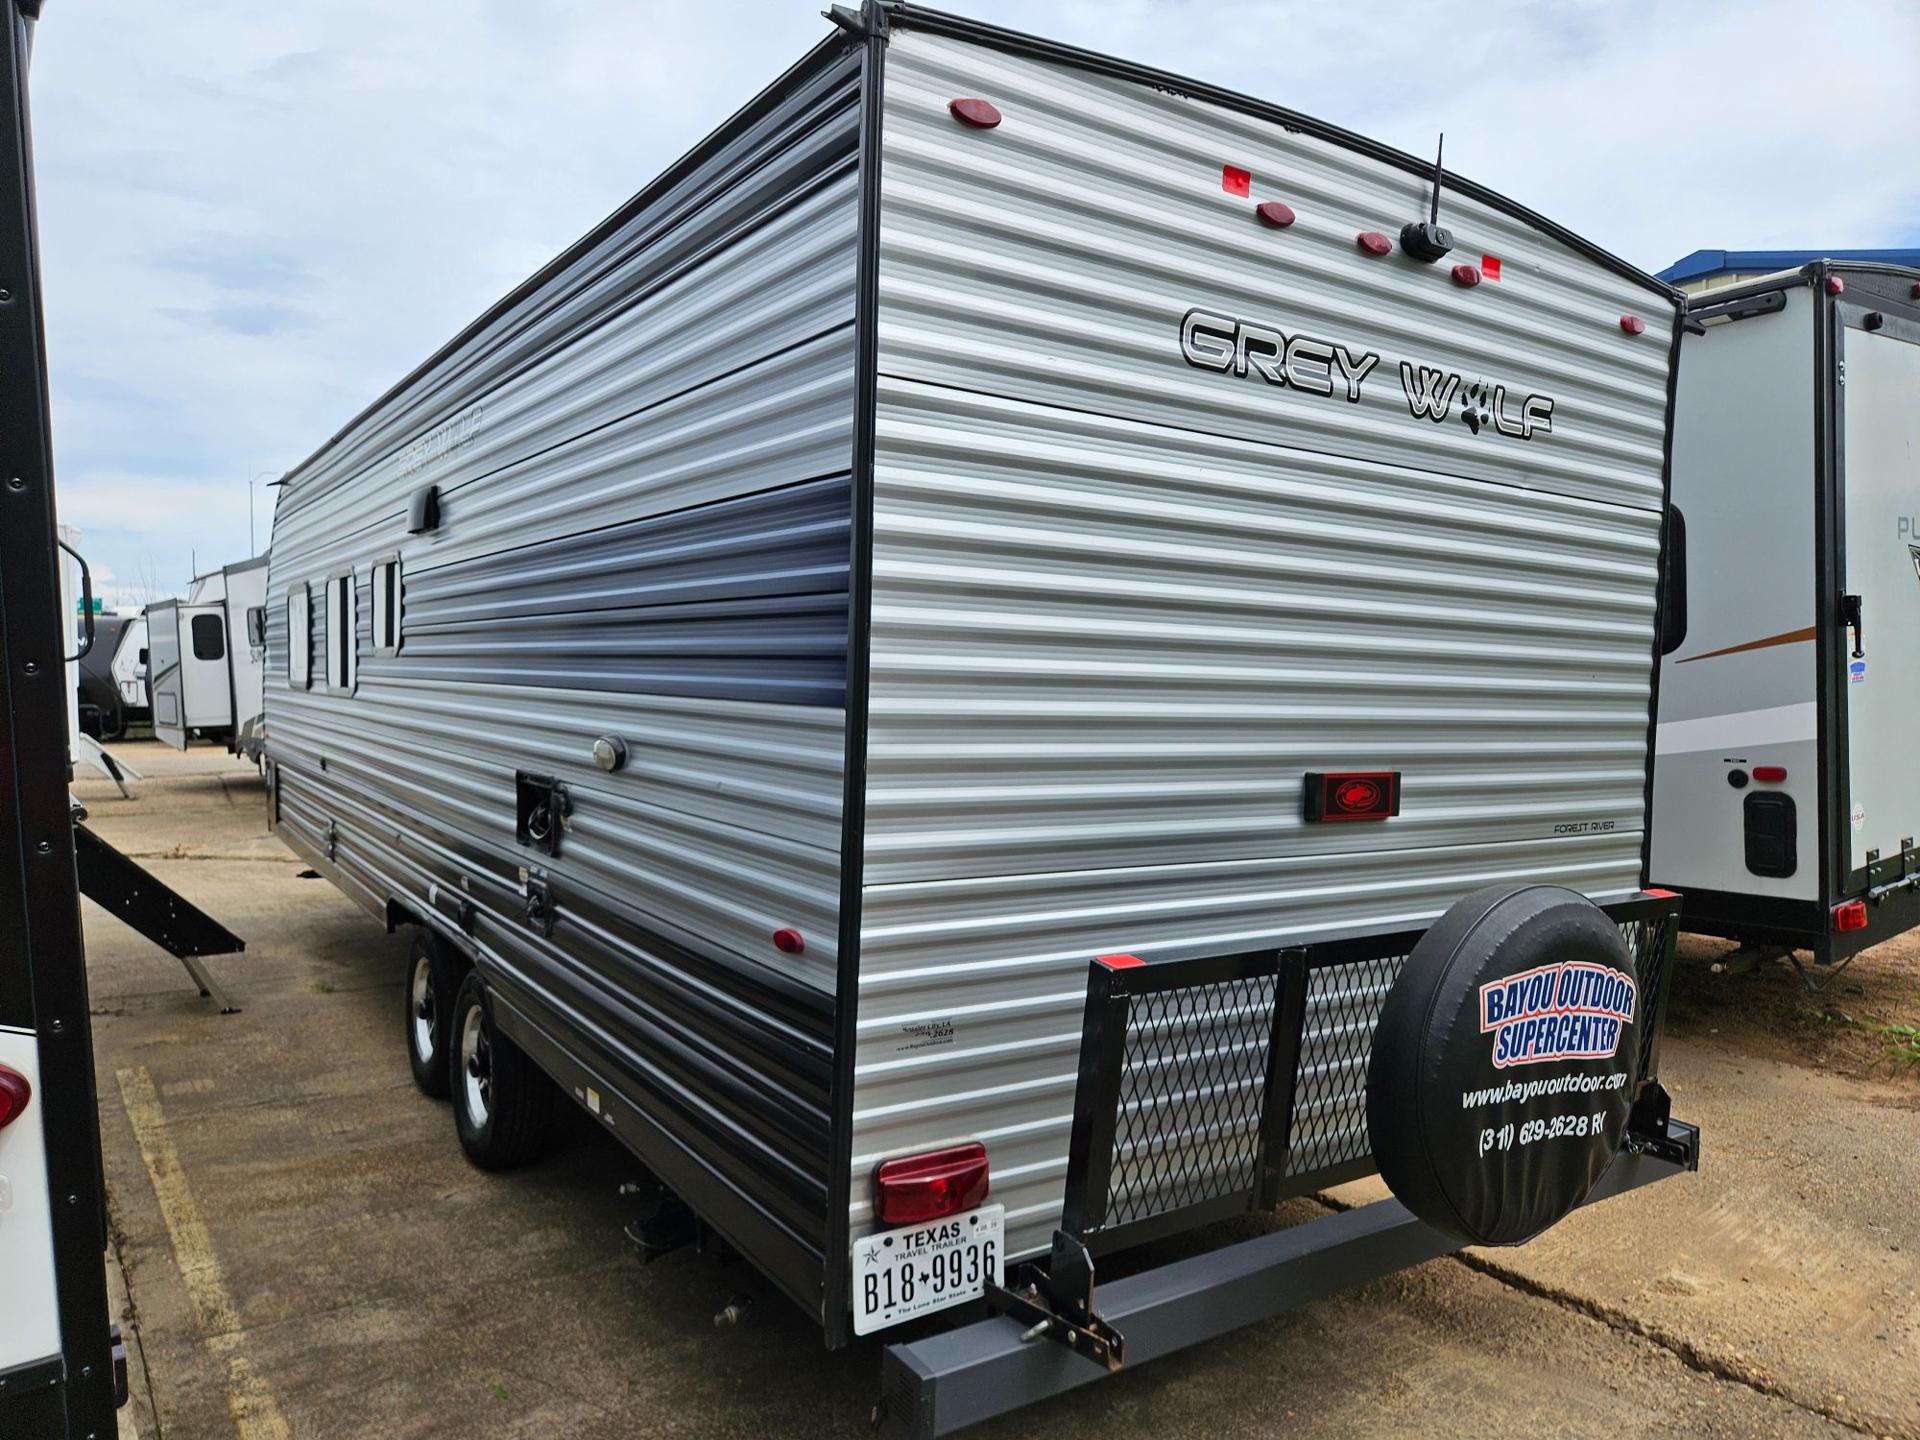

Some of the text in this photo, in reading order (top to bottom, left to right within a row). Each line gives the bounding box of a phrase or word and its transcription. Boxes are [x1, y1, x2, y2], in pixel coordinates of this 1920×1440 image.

[1179, 307, 1379, 403] GREY
[1554, 820, 1615, 834] FOREST RIVER
[1486, 968, 1635, 1024] BAYOU OUTDOOR
[1496, 1013, 1619, 1061] SUPERCENTER
[1519, 1115, 1588, 1146] 629-2628
[895, 1236, 967, 1262] TRAVEL TRAILER
[903, 1222, 961, 1250] TEXAS
[864, 1240, 996, 1315] B18 9936
